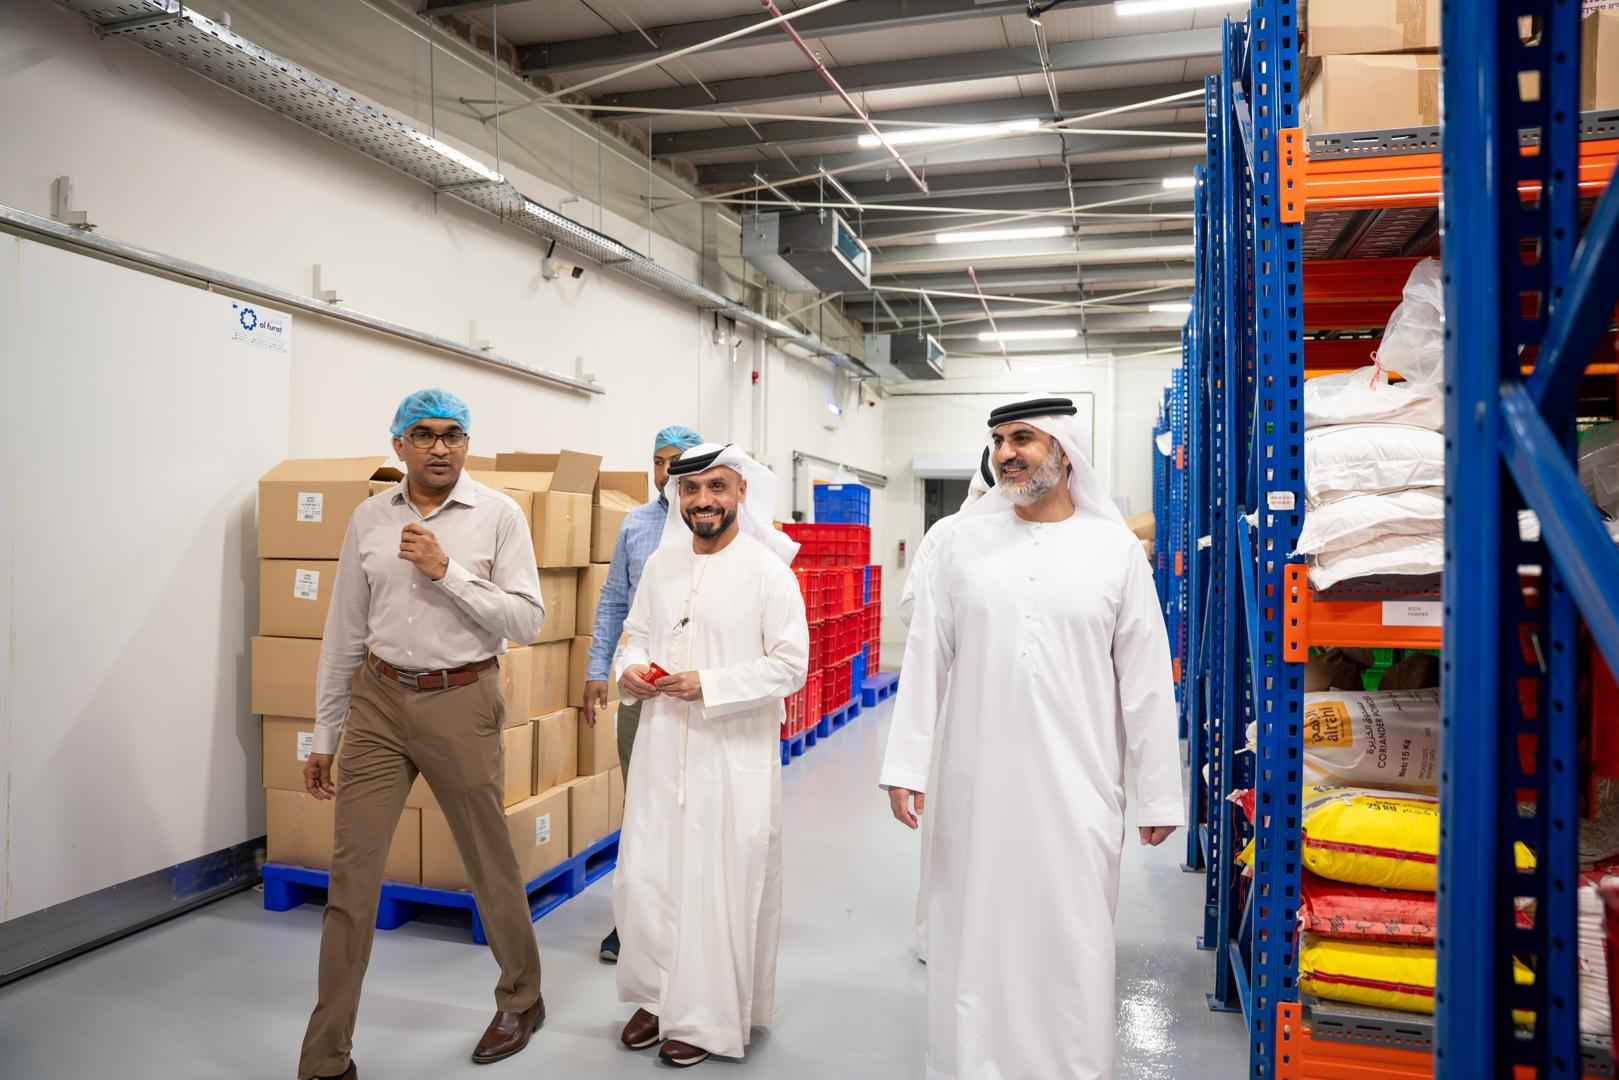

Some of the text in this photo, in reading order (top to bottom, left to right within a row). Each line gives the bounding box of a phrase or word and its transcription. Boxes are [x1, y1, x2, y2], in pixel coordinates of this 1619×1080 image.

[259, 321, 266, 329] al
[267, 322, 282, 333] furat
[1375, 718, 1387, 769] CORIANDER
[1403, 739, 1412, 750] Kg
[1401, 751, 1410, 761] 15
